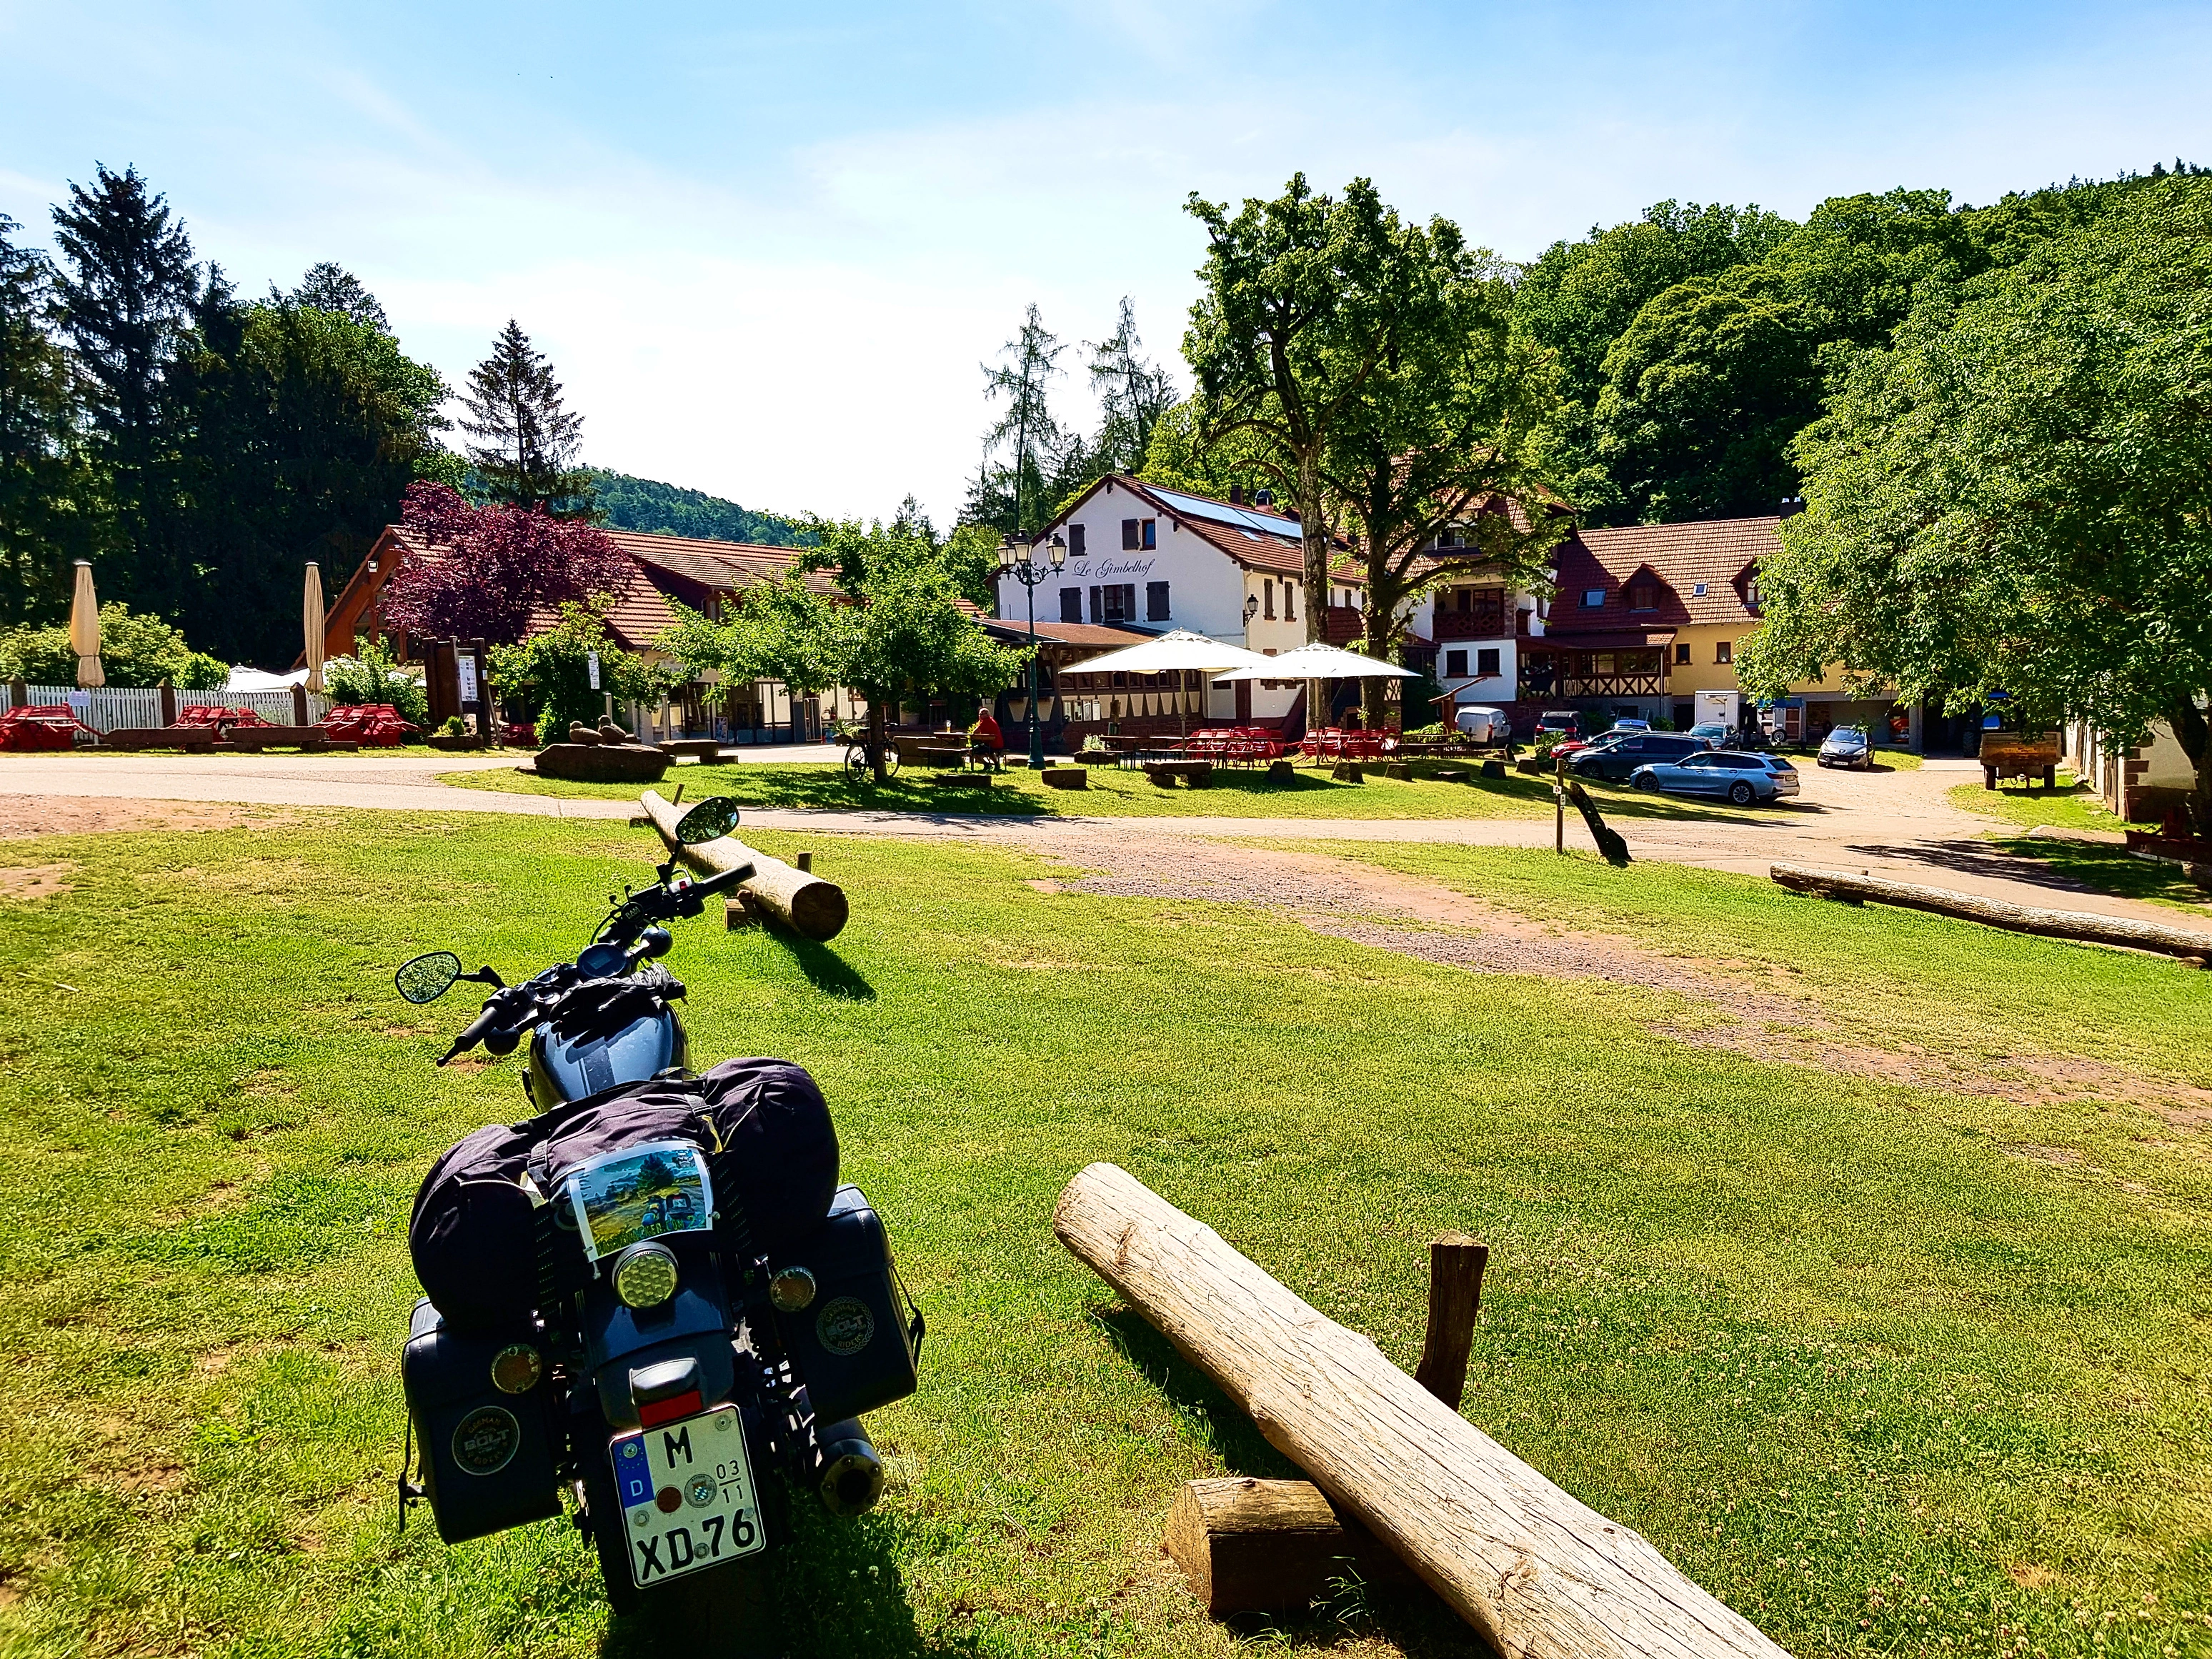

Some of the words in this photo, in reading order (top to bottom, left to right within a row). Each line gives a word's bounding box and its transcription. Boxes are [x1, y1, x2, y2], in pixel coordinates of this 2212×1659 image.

[1072, 560, 1092, 577] Le
[1095, 557, 1155, 579] Gimbelhof
[625, 906, 641, 920] RAM
[837, 1332, 864, 1348] RIDERS
[663, 1426, 693, 1469] M
[630, 1479, 644, 1497] D
